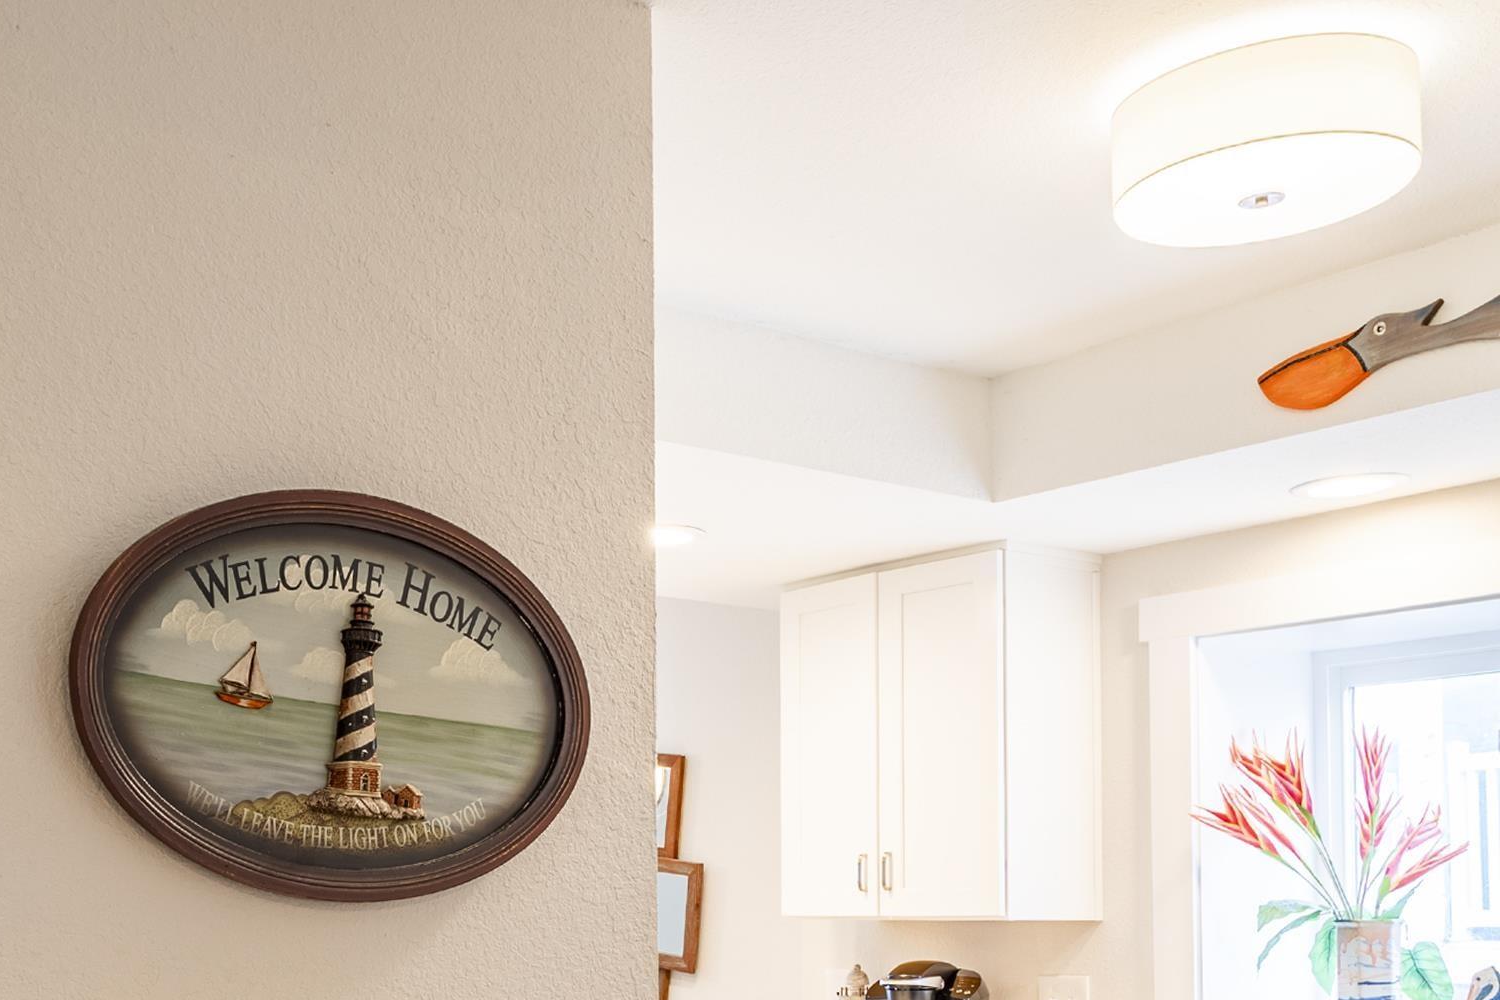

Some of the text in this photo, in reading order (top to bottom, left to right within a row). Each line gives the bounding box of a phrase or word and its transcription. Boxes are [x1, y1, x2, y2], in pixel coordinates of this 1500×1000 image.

[185, 554, 502, 651] WELCOME HOME
[240, 807, 295, 845] LEAVE
[300, 824, 334, 849] THE
[339, 826, 389, 850] LIGHT
[394, 823, 421, 848] ON
[422, 817, 456, 843] FOR
[452, 797, 486, 832] YOU
